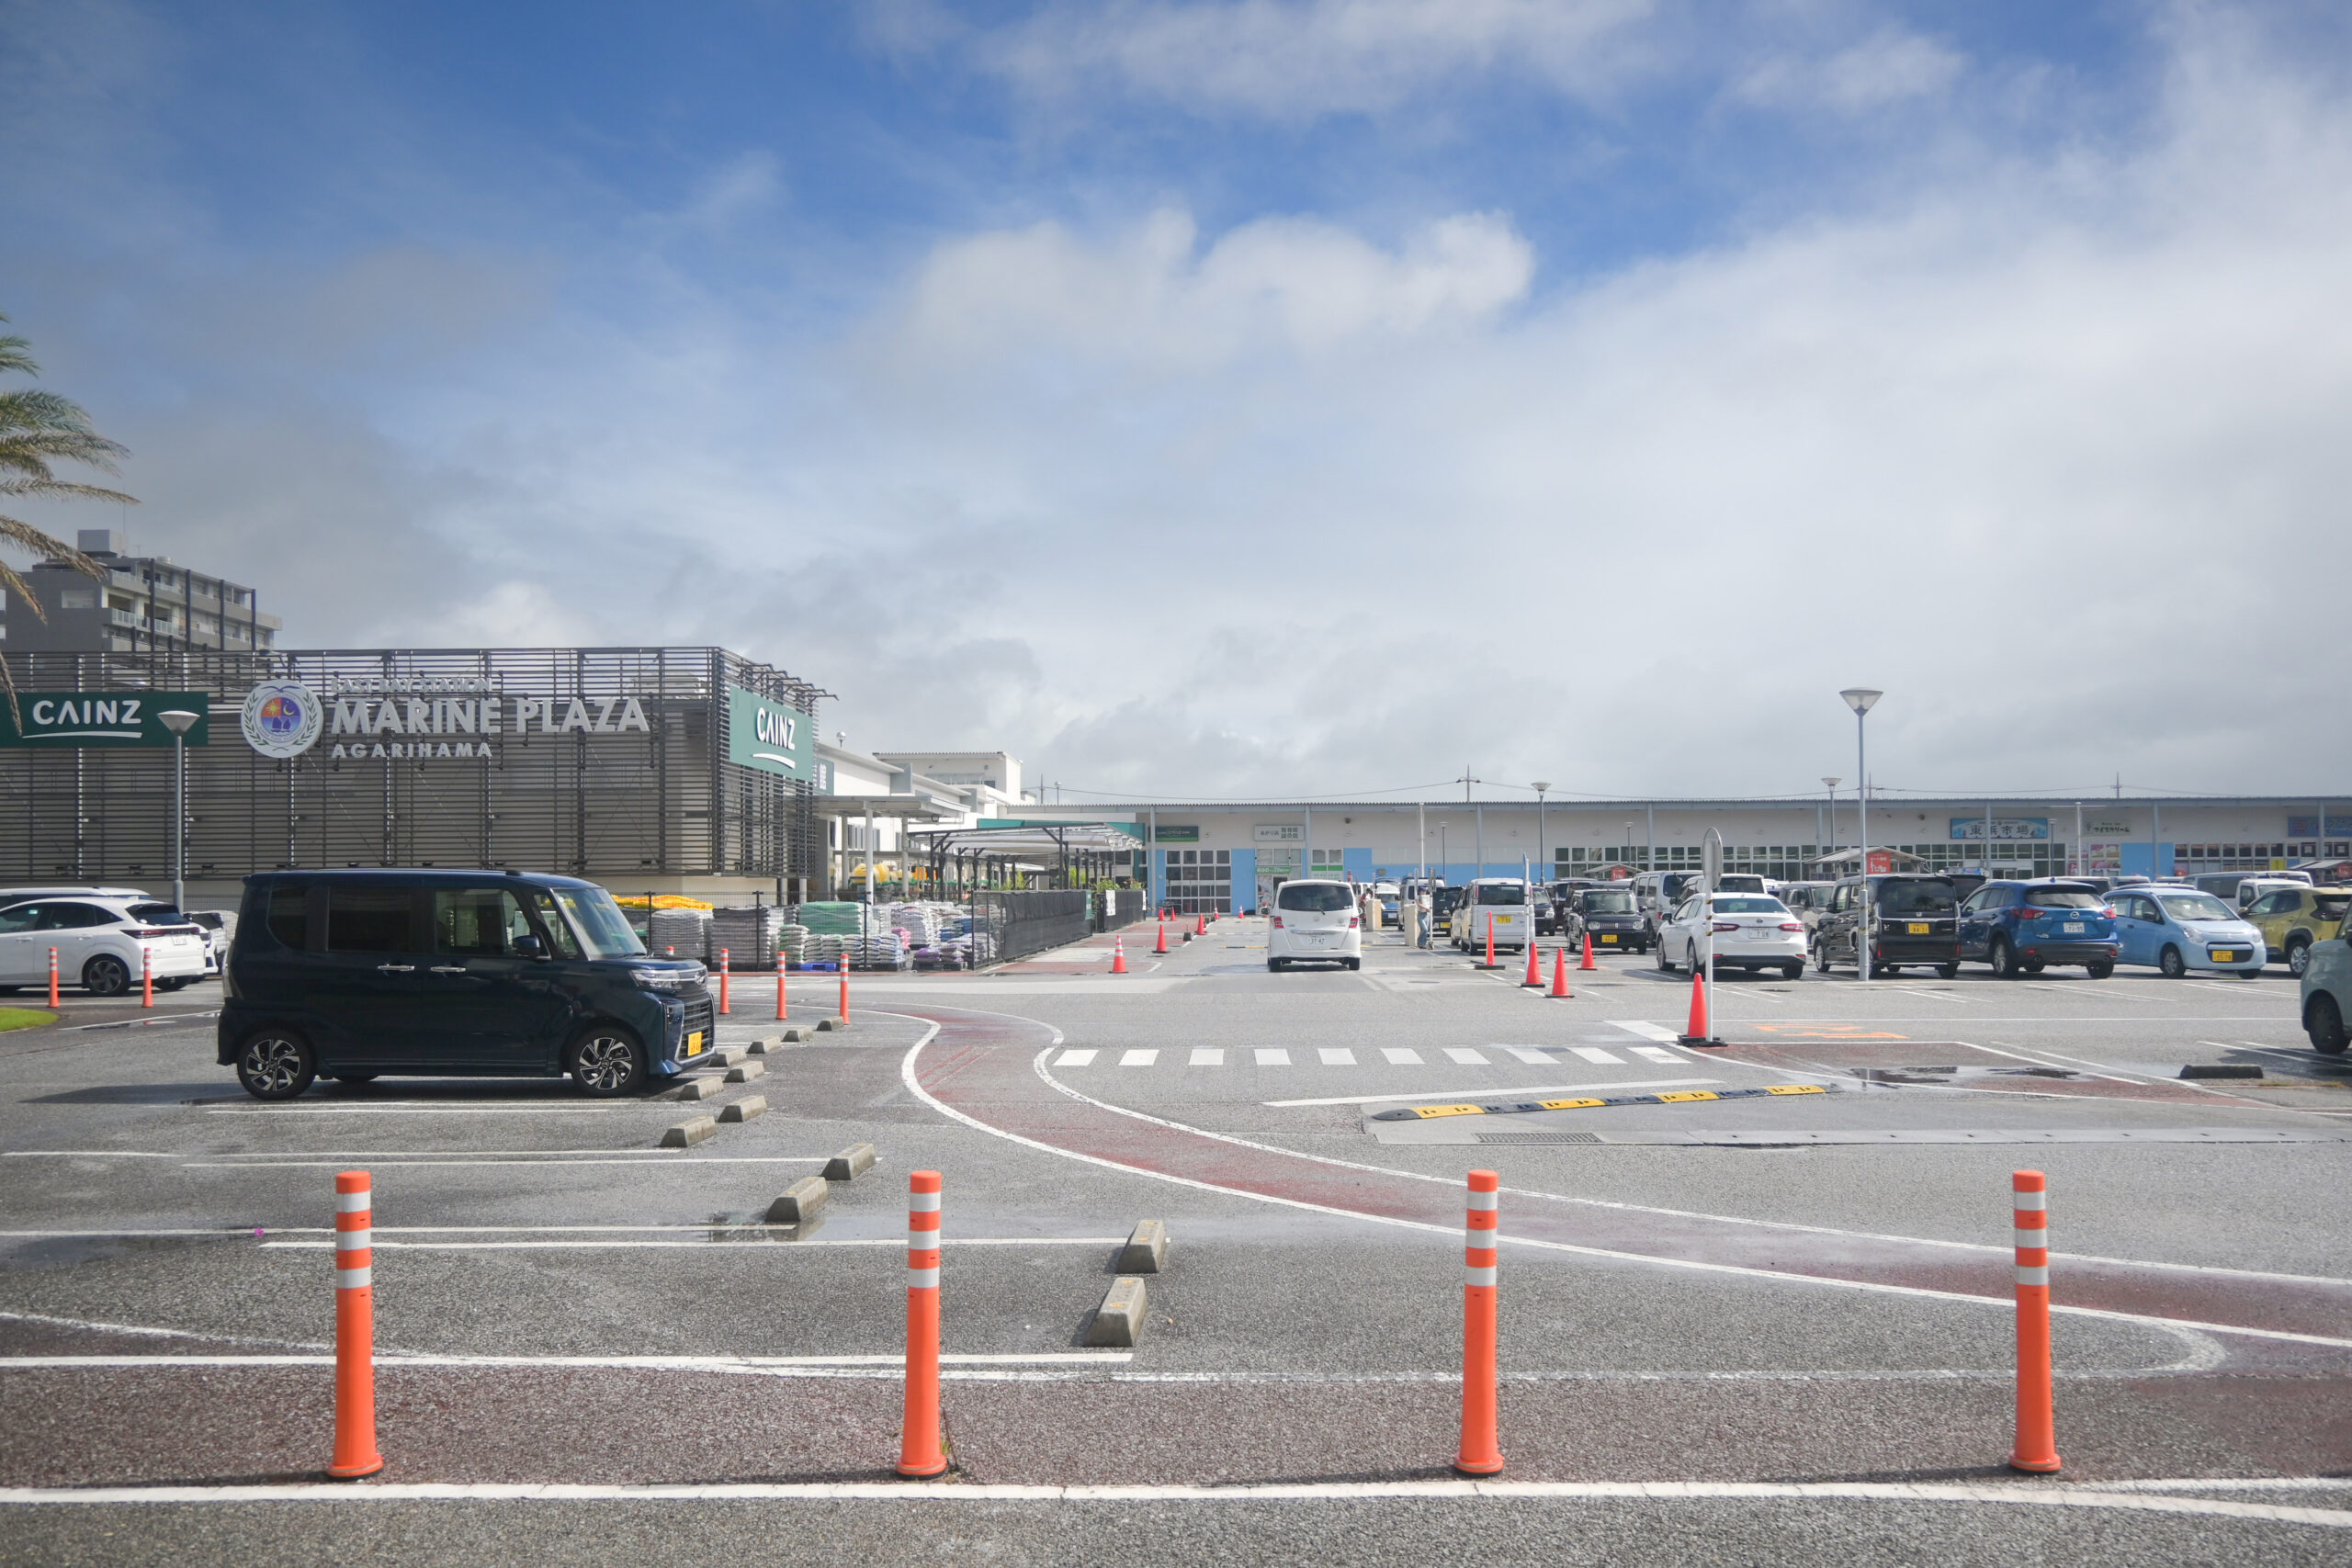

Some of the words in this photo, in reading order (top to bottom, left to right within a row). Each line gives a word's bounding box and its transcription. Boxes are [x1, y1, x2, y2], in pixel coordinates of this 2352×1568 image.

[379, 678, 413, 693] BAY
[419, 678, 492, 693] STATION
[32, 700, 142, 725] CAINZ
[331, 698, 502, 734] MARINE
[516, 698, 650, 733] PLAZA
[757, 707, 796, 750] CAINZ
[331, 742, 492, 759] AGARIHAMA
